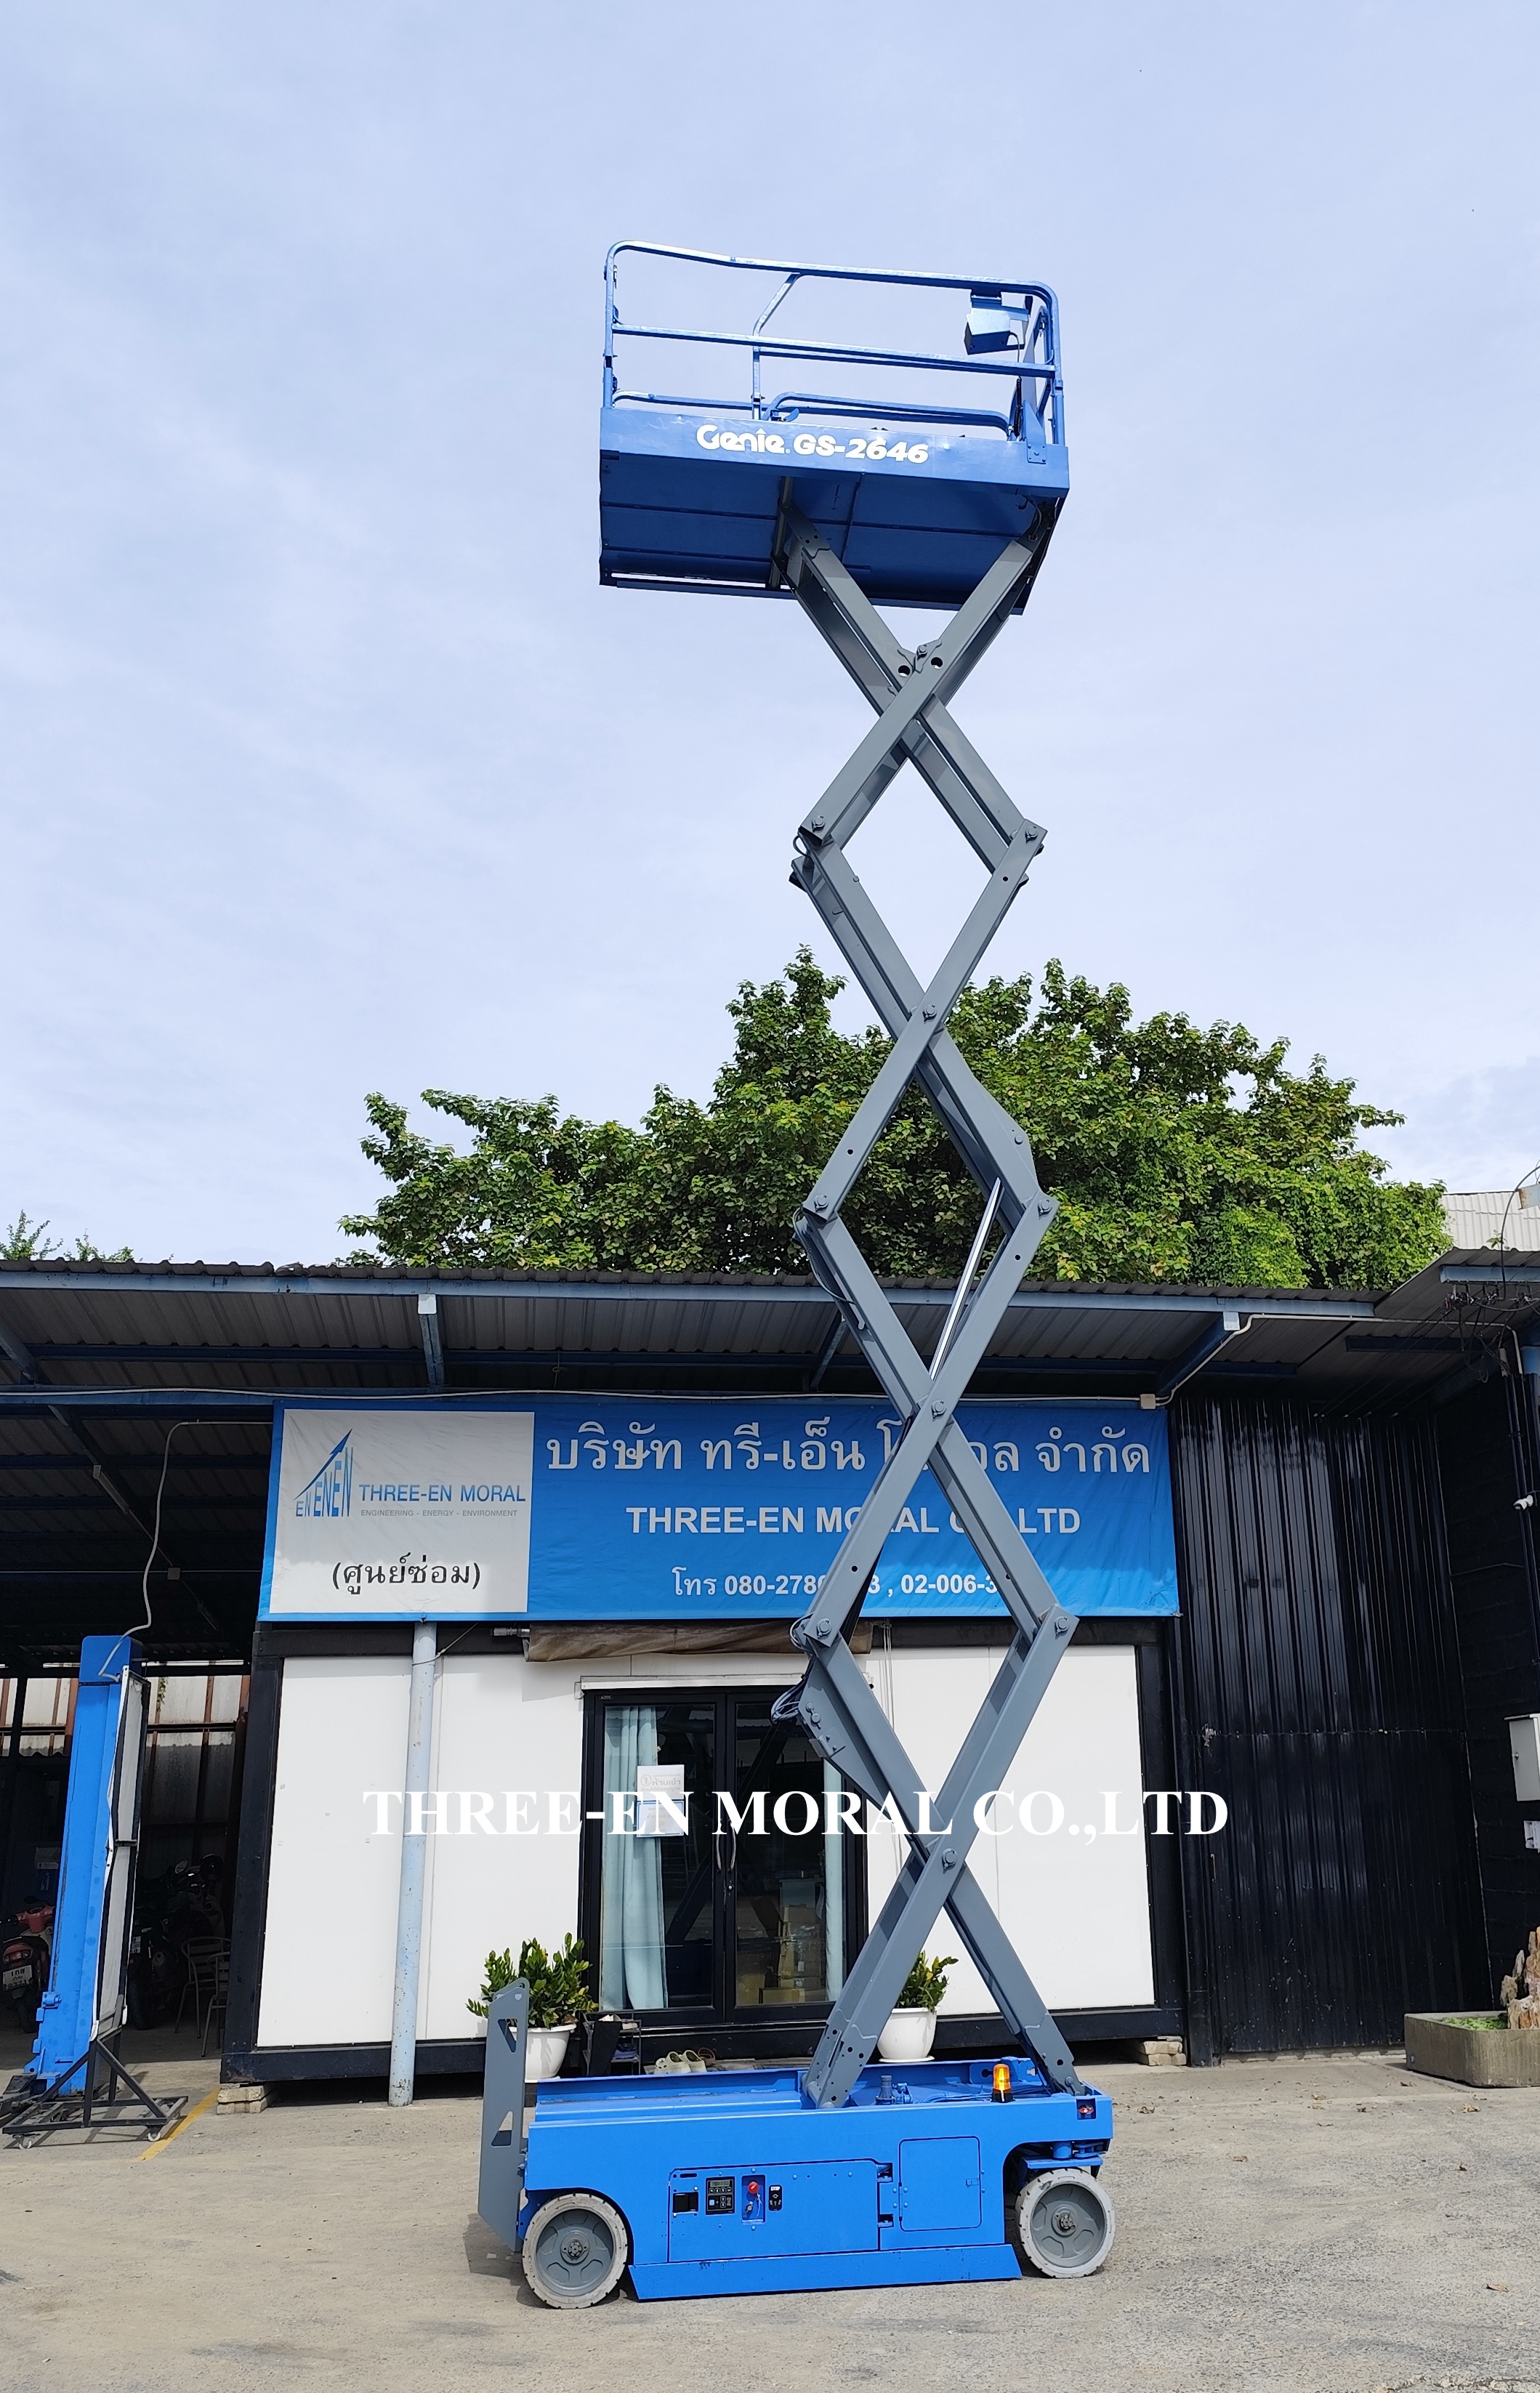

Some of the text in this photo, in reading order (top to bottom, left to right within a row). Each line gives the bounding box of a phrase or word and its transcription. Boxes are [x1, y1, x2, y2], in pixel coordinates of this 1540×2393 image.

[793, 433, 930, 464] GS-2646
[546, 1421, 683, 1471] บริษัท
[701, 1416, 866, 1471] ทรี-เอ็น
[1034, 1426, 1151, 1474] จำกัด
[359, 1485, 526, 1502] THREE-EN MORAL
[626, 1507, 803, 1533] THREE-EN
[331, 1552, 480, 1595] (ศูนย์ซ่อม)
[672, 1567, 717, 1596] โทร
